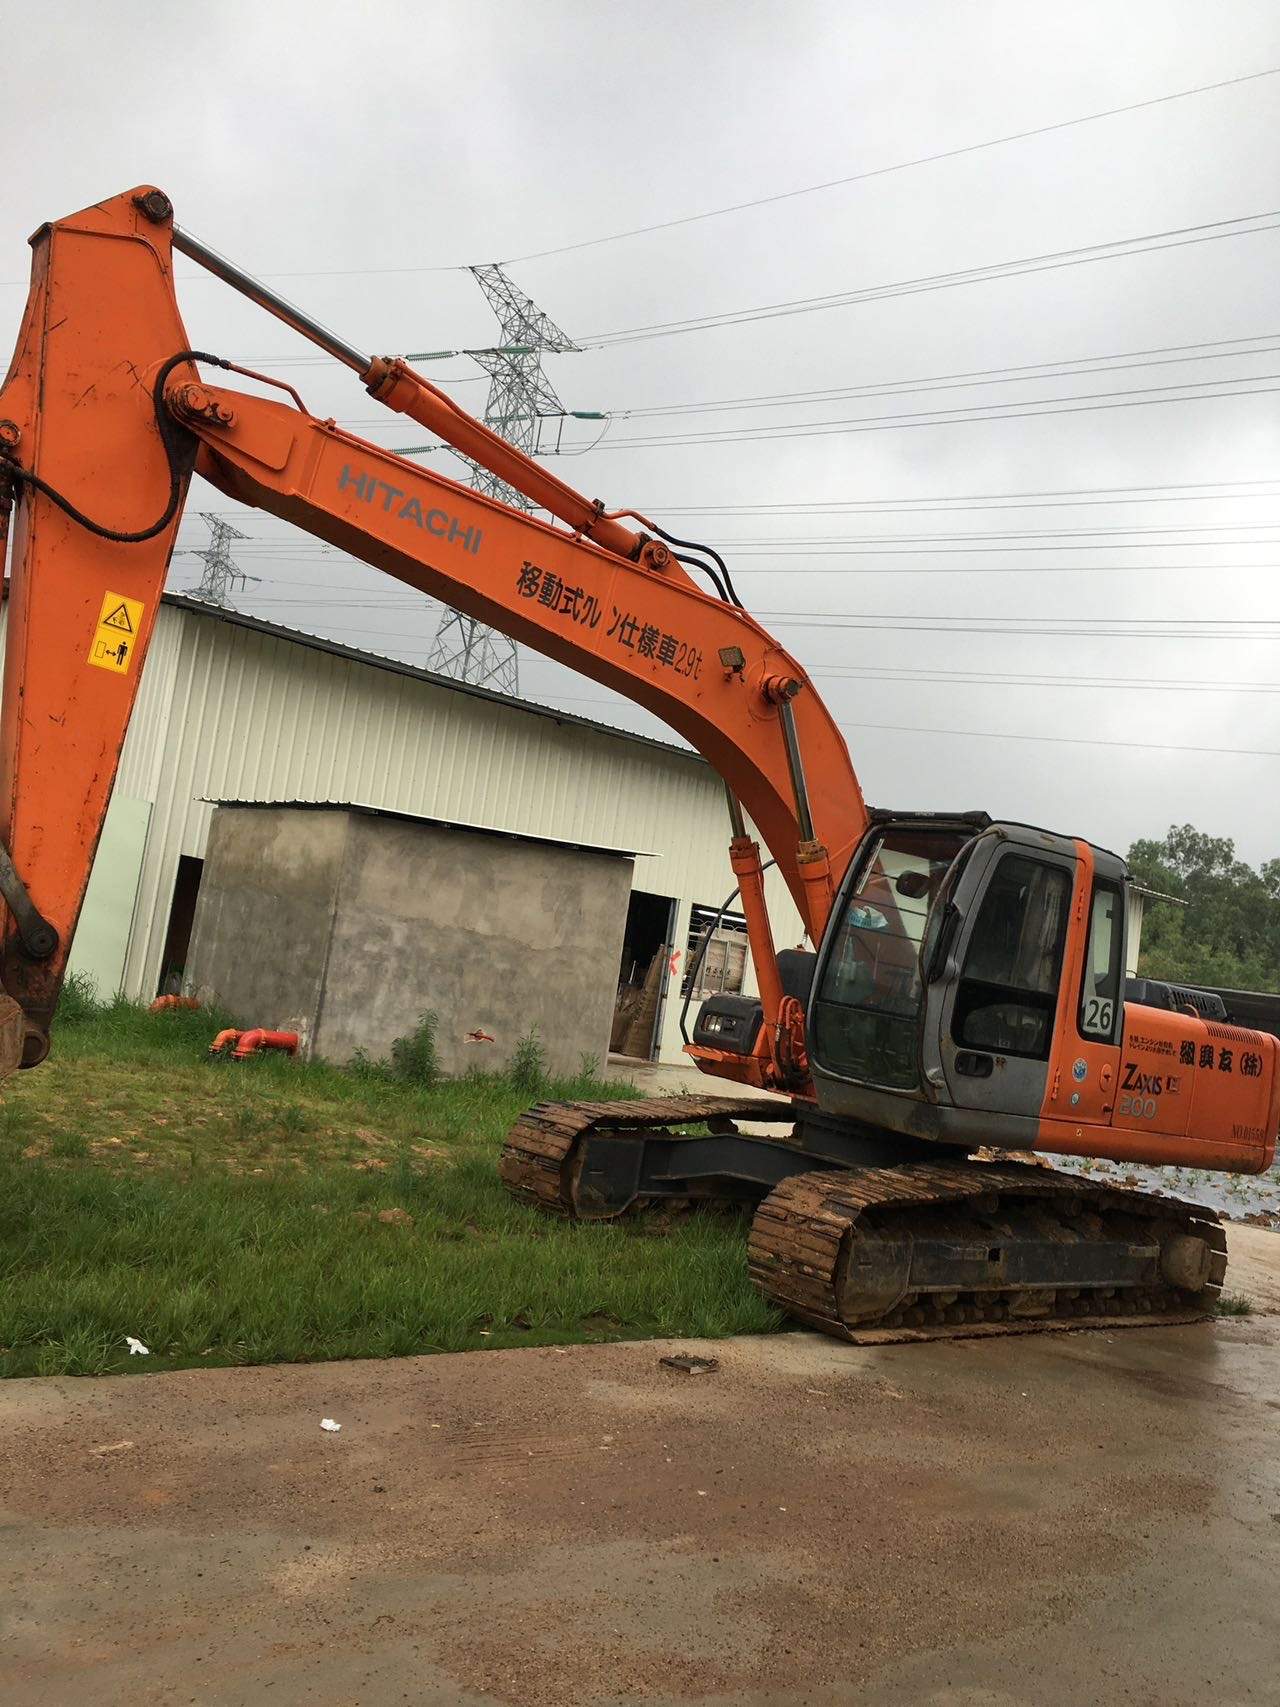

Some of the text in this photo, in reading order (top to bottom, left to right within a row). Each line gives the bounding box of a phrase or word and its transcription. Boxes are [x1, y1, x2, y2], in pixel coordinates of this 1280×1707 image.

[337, 464, 484, 556] HITACHI
[1086, 999, 1112, 1030] 26
[1119, 1097, 1157, 1120] 200
